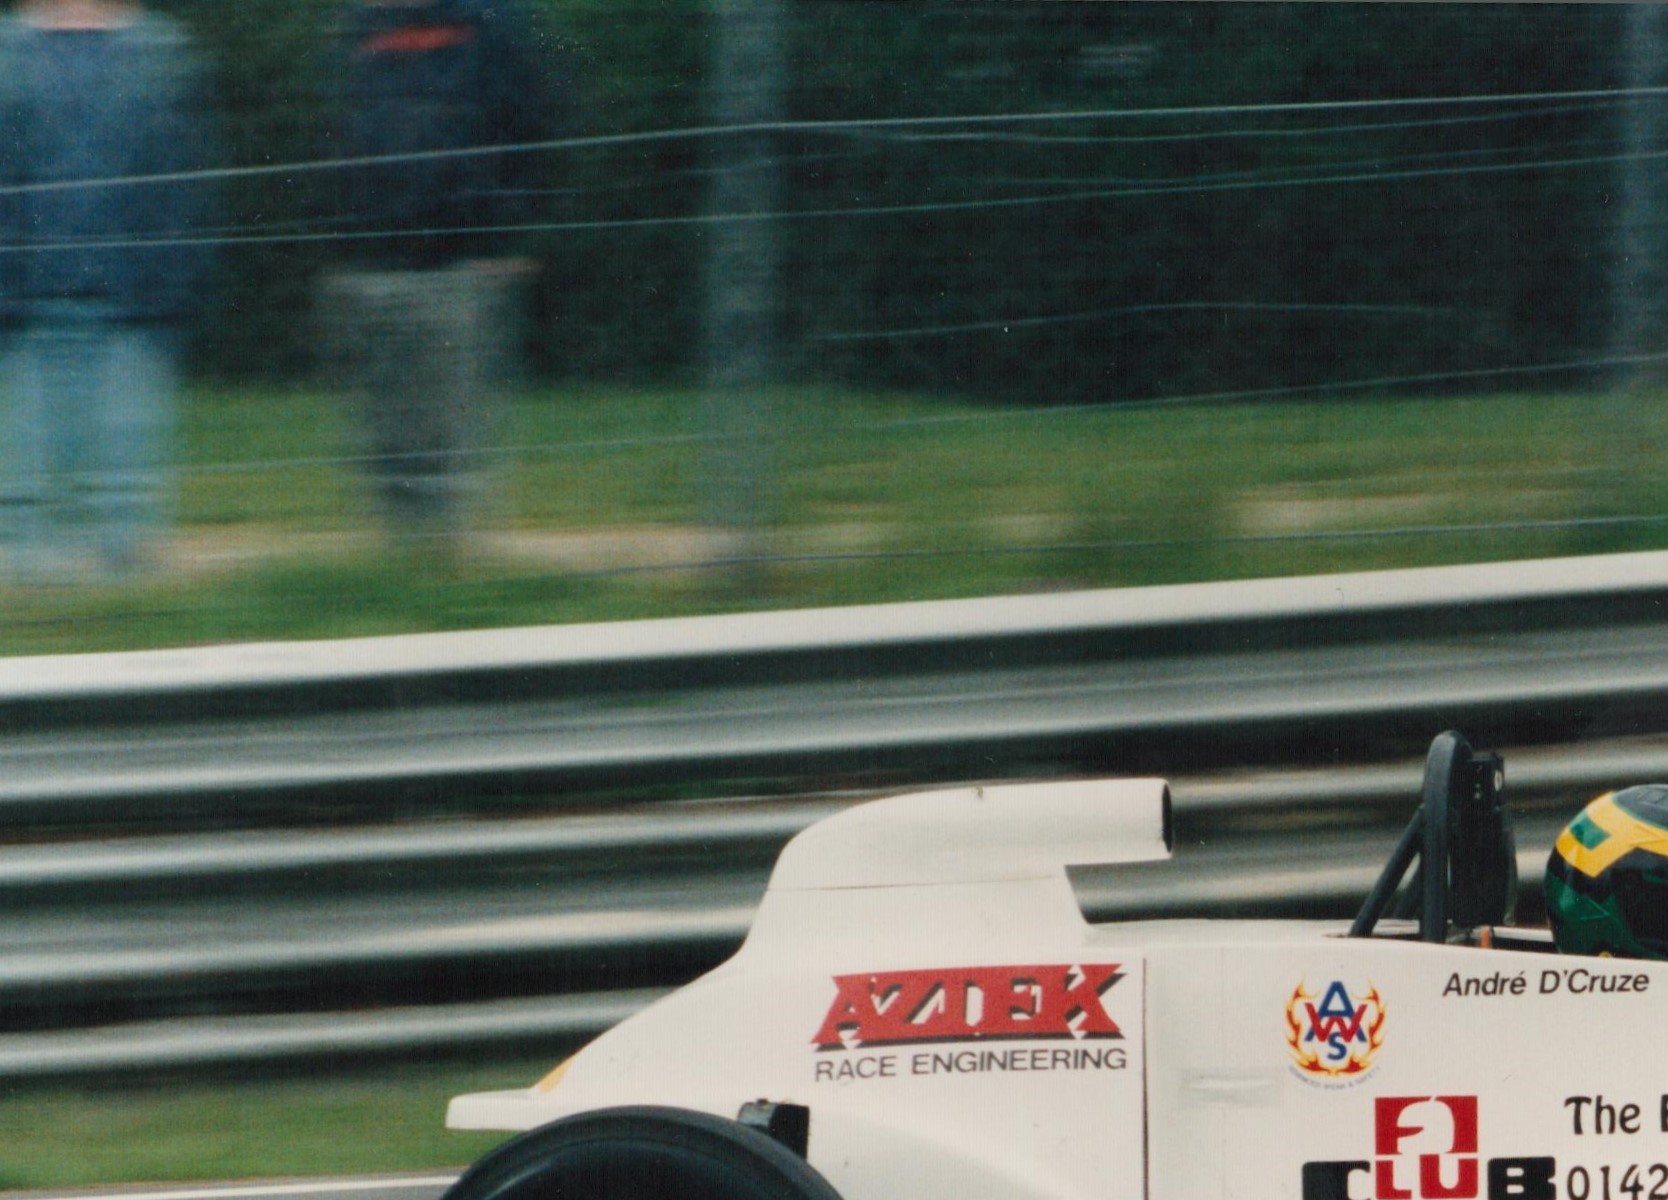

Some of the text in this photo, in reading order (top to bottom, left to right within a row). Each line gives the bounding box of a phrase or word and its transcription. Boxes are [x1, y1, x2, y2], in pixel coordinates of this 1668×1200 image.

[1443, 968, 1651, 997] André D'Cruze
[814, 1047, 1128, 1083] RACE ENGINEERING
[1564, 1094, 1641, 1136] The
